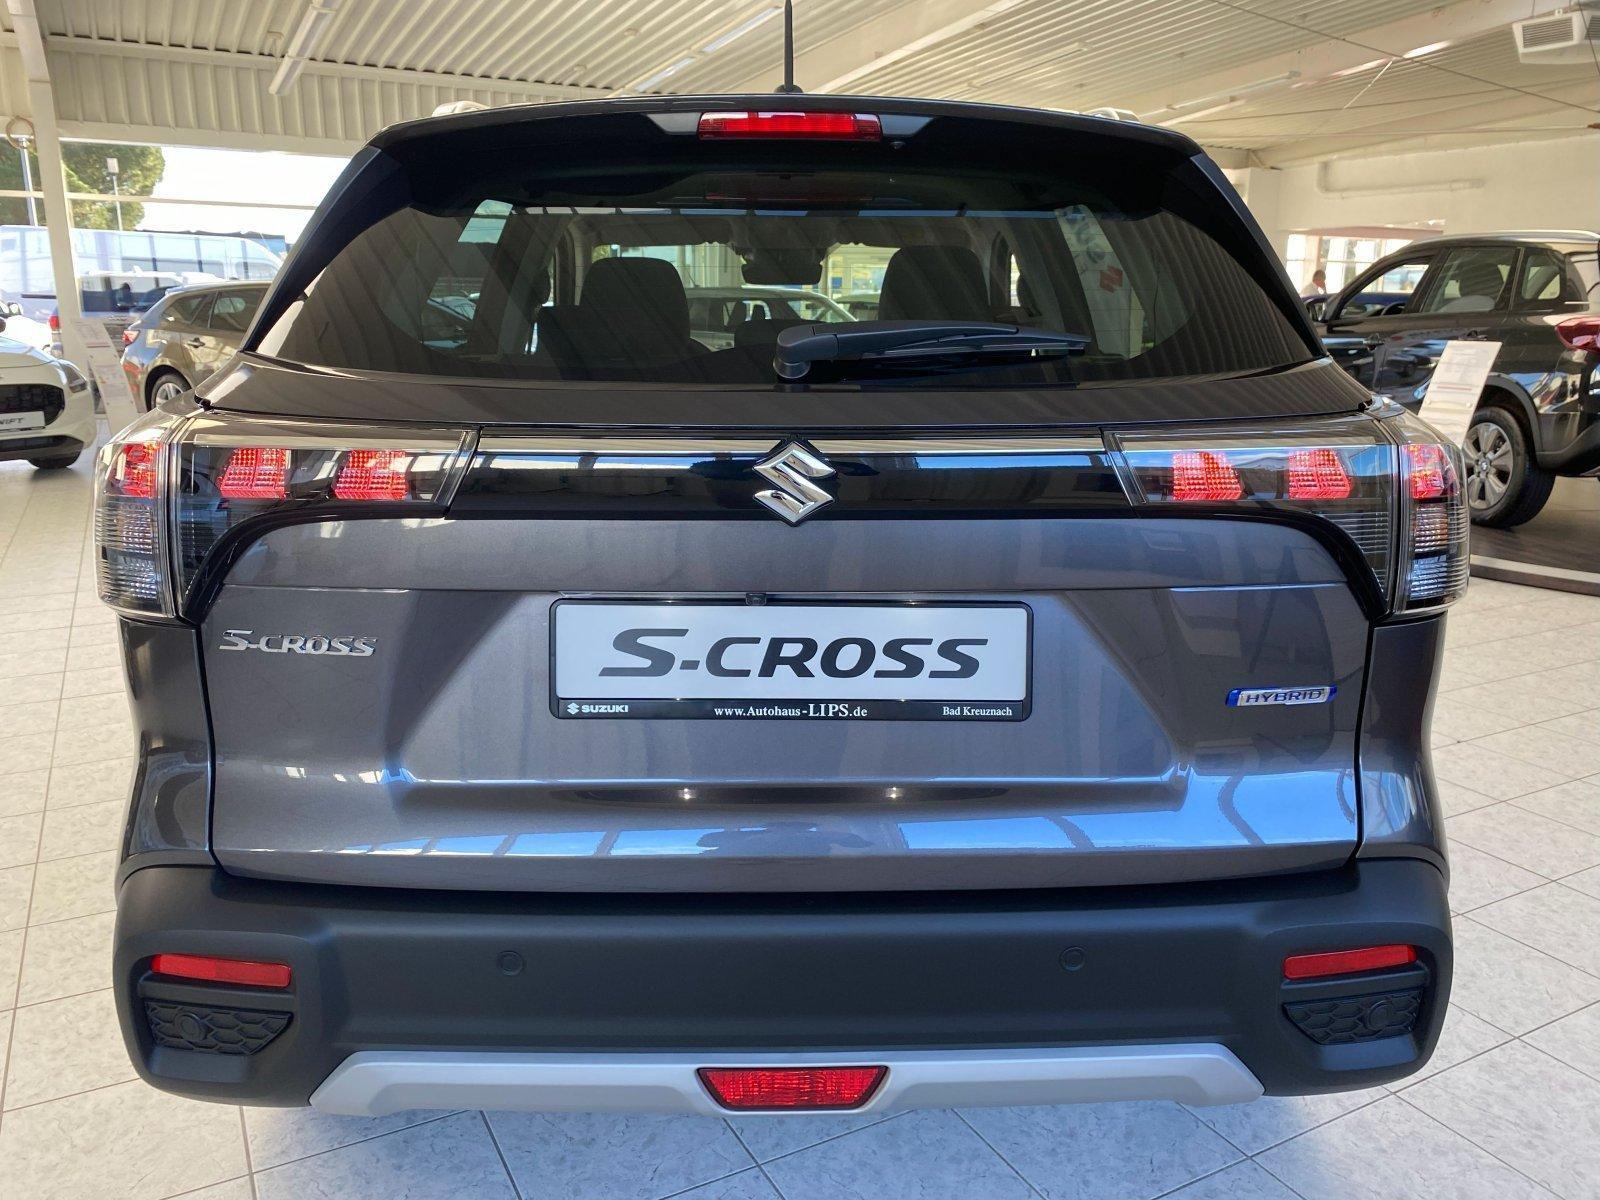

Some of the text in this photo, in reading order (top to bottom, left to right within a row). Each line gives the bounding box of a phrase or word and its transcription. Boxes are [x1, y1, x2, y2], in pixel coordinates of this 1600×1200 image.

[218, 628, 378, 657] S-CROSS
[598, 628, 989, 679] S-CROSS
[1245, 687, 1326, 704] HYBRID
[581, 704, 629, 713] SUZUKI
[713, 702, 869, 717] www.Autohaus-LIPS.de
[942, 706, 1013, 716] Bad Kreuznach
